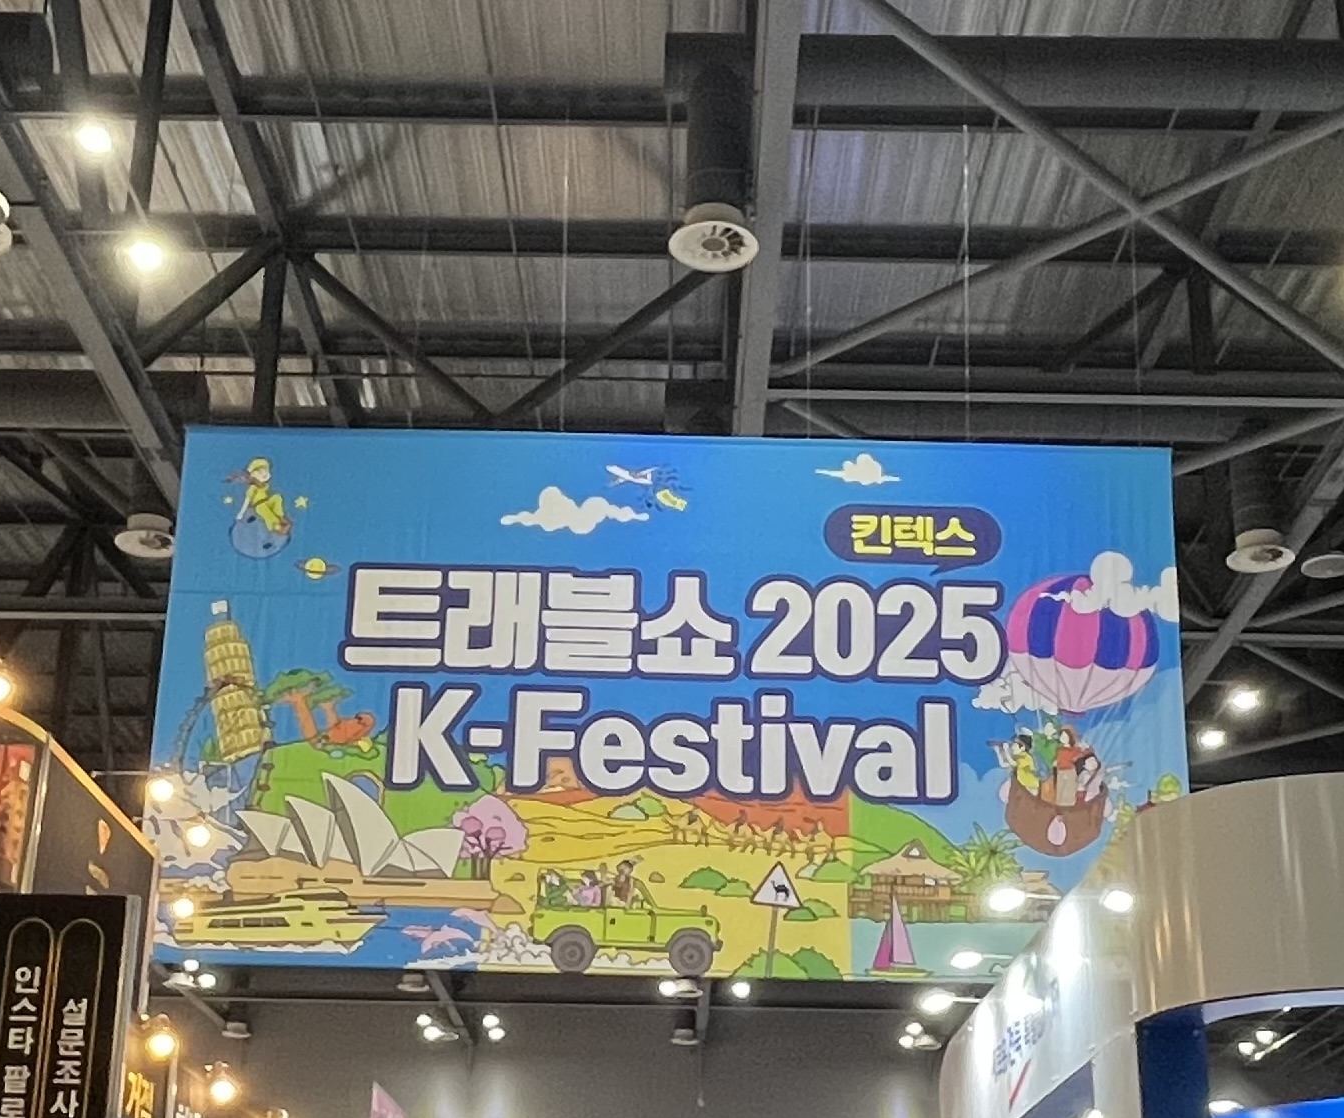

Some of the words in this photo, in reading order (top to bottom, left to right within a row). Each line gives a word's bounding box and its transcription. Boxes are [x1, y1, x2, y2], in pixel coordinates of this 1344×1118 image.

[851, 514, 979, 557] 킨텍스
[345, 566, 739, 677] 트래블쇼
[750, 579, 1003, 680] 2025
[392, 688, 954, 801] K-Festival
[7, 965, 42, 1055] 인스타
[49, 998, 88, 1118] 설문조사
